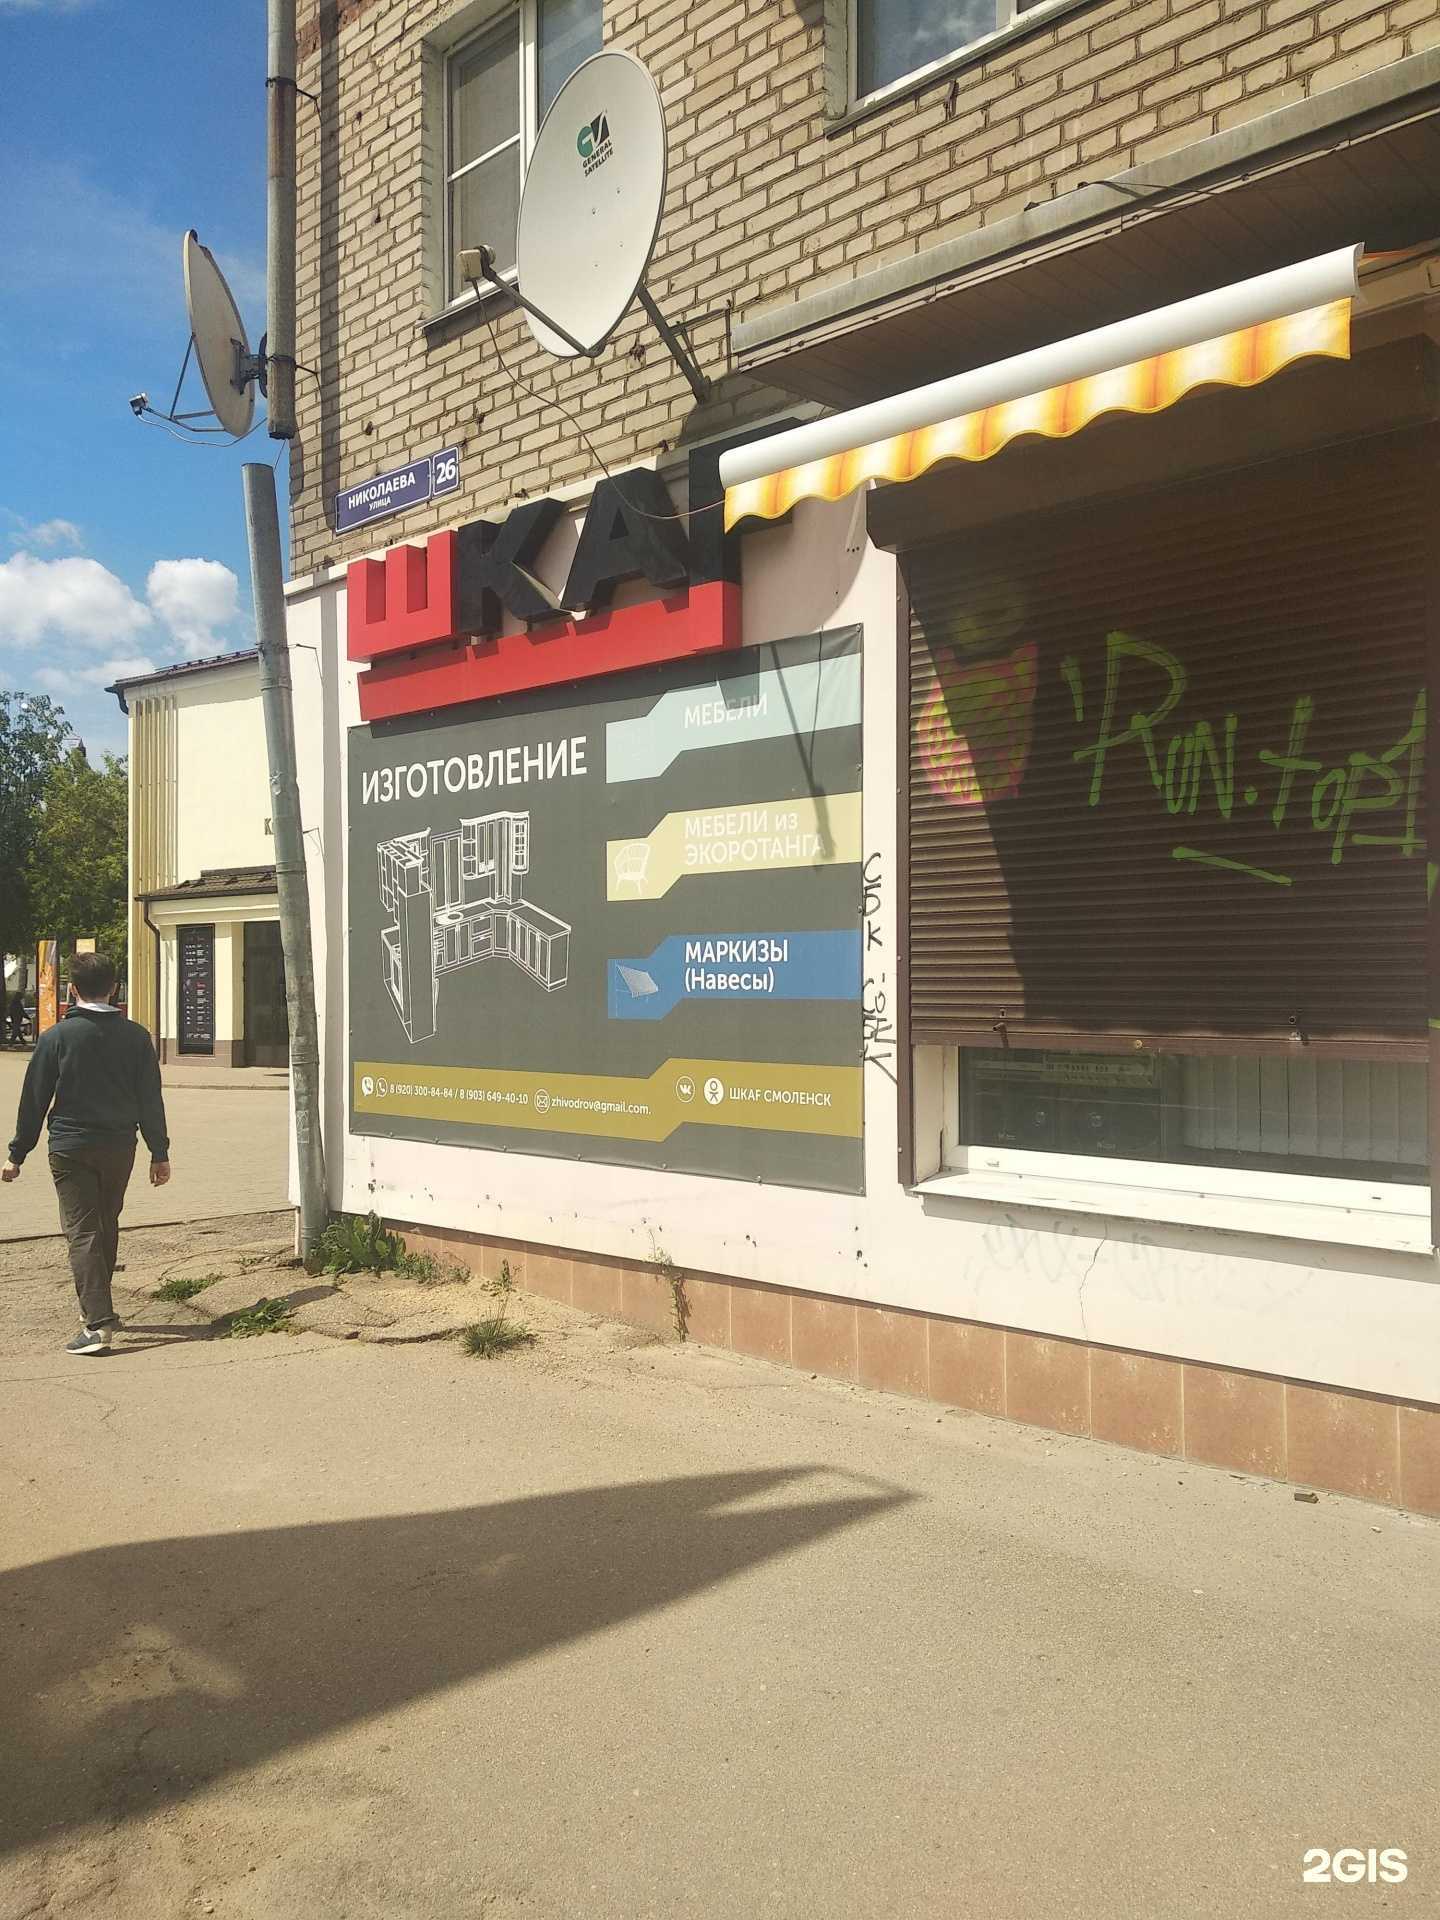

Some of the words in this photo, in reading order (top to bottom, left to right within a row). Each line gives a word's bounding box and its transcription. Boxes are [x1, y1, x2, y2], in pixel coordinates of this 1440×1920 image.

[582, 139, 612, 168] GENERAL
[584, 147, 614, 177] SATELLITE
[436, 457, 456, 485] 26
[348, 471, 416, 510] НИКОЛАЕВА
[368, 496, 392, 511] УЛИЦА
[684, 695, 768, 729] МЕБЕЛИ
[361, 735, 588, 805] ИЗГОТОВЛЕНИЕ
[685, 810, 768, 839] МЕБЕЛИ
[775, 813, 798, 832] из
[685, 833, 826, 866] ЭКОРОТАНГА
[685, 939, 789, 963] МАРКИЗЫ
[685, 966, 775, 993] (Навесы)
[389, 1083, 395, 1093] 8
[395, 1084, 413, 1096] (920)
[414, 1085, 453, 1098] 300-84-84
[459, 1089, 465, 1099] 8
[466, 1089, 485, 1102] (903)
[486, 1090, 529, 1105] 649-40-10
[551, 1097, 652, 1115] zhivodrov@gmail.com.
[763, 1090, 832, 1107] СМОЛЕНСК
